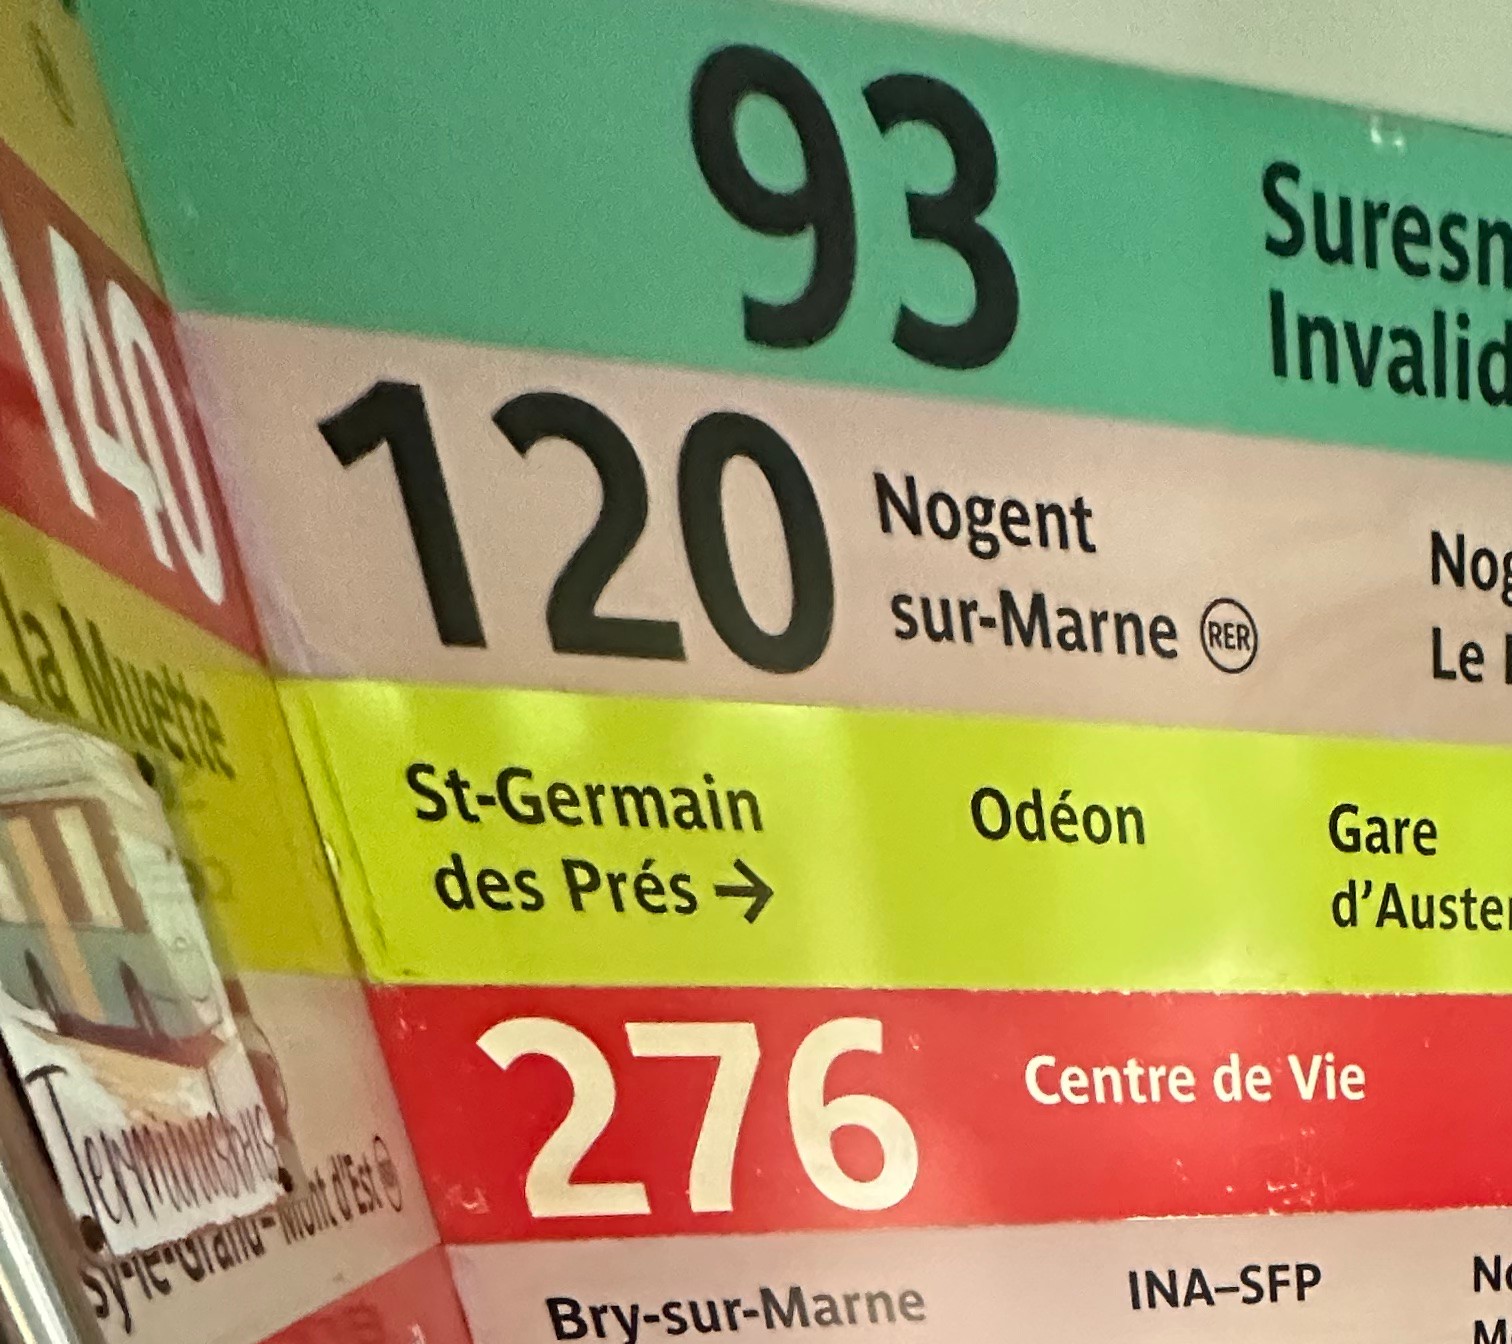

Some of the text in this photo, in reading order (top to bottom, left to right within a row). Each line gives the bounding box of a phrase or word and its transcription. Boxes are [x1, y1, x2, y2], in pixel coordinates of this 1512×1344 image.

[689, 43, 1019, 371] 93
[318, 381, 834, 674] 120
[873, 473, 1096, 563] Nogent
[889, 589, 1177, 660] sur-Marne
[1432, 626, 1485, 685] Le
[57, 602, 237, 781] Muette
[404, 762, 763, 833] St-Germain
[970, 787, 1146, 846] Odéon
[1328, 803, 1438, 858] Gare
[434, 854, 698, 917] des Prés
[1023, 1052, 1367, 1105] Centre de Vie
[476, 1016, 919, 1218] 276
